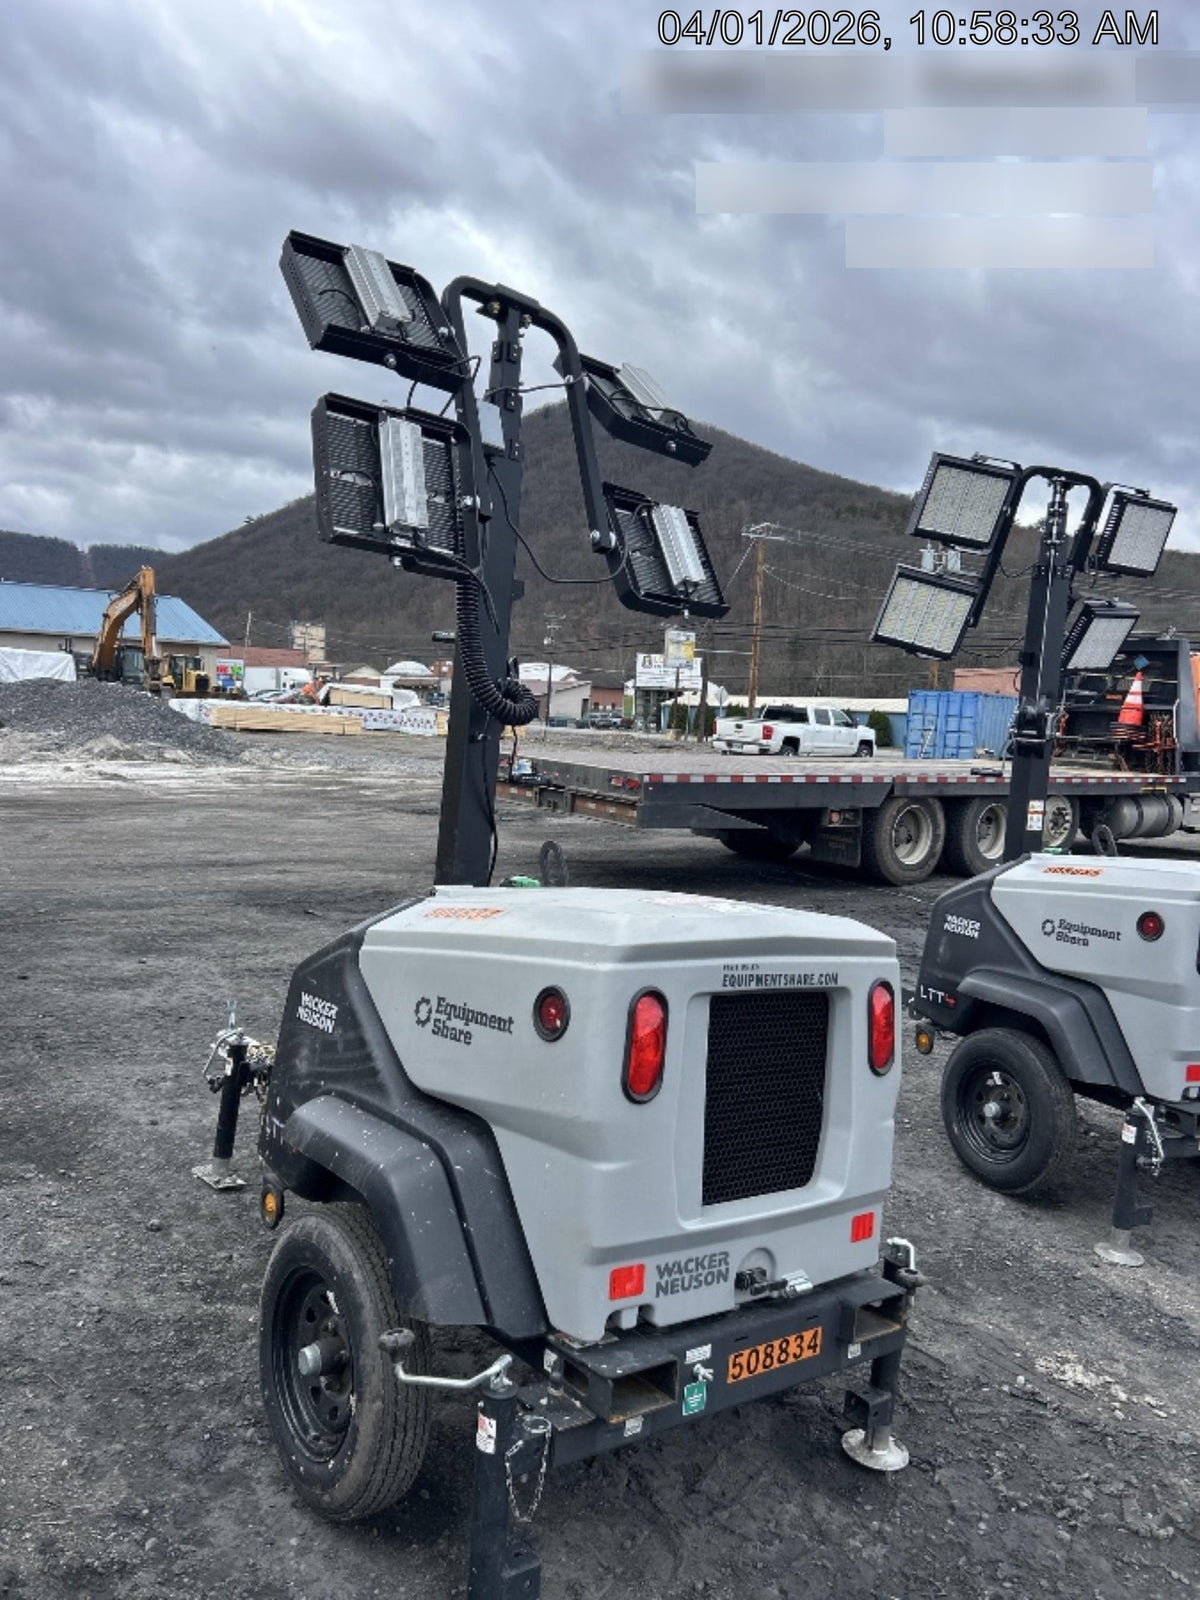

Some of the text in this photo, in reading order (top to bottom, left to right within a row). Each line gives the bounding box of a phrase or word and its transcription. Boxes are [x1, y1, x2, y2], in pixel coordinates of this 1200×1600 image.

[1055, 930, 1090, 947] Share
[1058, 919, 1121, 941] Equipment
[722, 973, 838, 988] EQUIPMENTSHARE.COM
[296, 1006, 335, 1034] NEUSON
[435, 996, 514, 1034] Equipment
[431, 1018, 473, 1045] Share
[655, 1251, 730, 1280] WACKER
[655, 1267, 730, 1298] NEUSON
[729, 1329, 820, 1381] 508834
